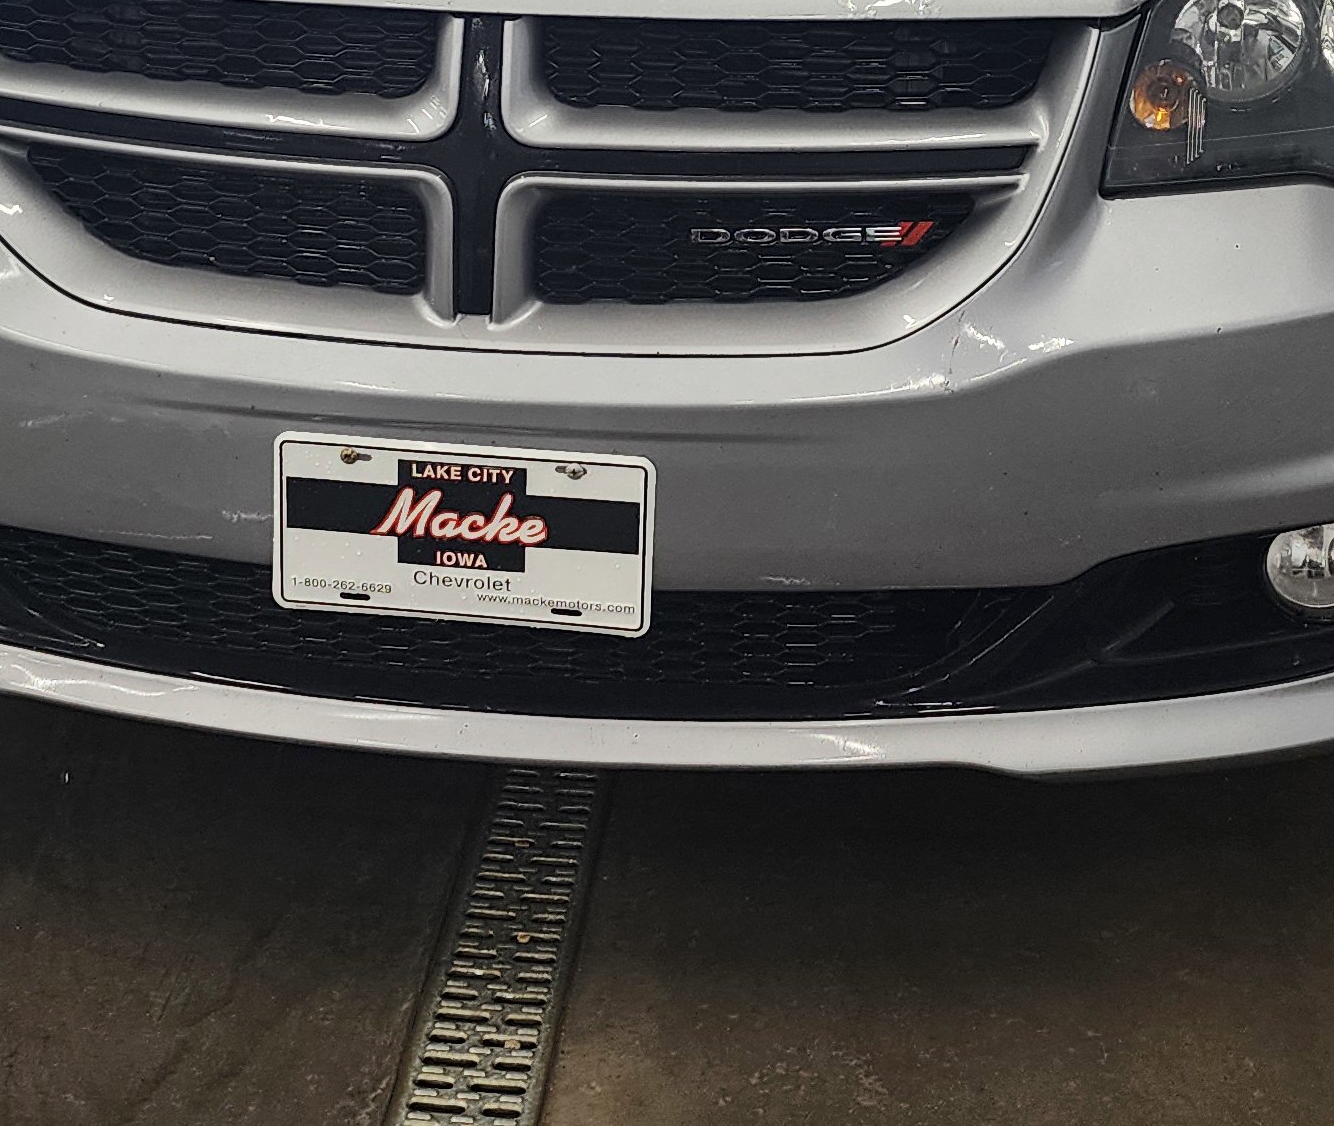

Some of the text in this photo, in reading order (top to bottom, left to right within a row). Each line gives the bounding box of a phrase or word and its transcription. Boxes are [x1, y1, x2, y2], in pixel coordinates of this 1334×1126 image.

[690, 226, 903, 243] DODGE
[411, 462, 514, 485] LAKE CITY
[369, 485, 548, 546] Macke
[435, 550, 488, 569] IOWA
[291, 576, 392, 594] 1-800-262-6629
[413, 570, 512, 592] Chevrolet
[476, 593, 636, 615] www.mackemotors.com
